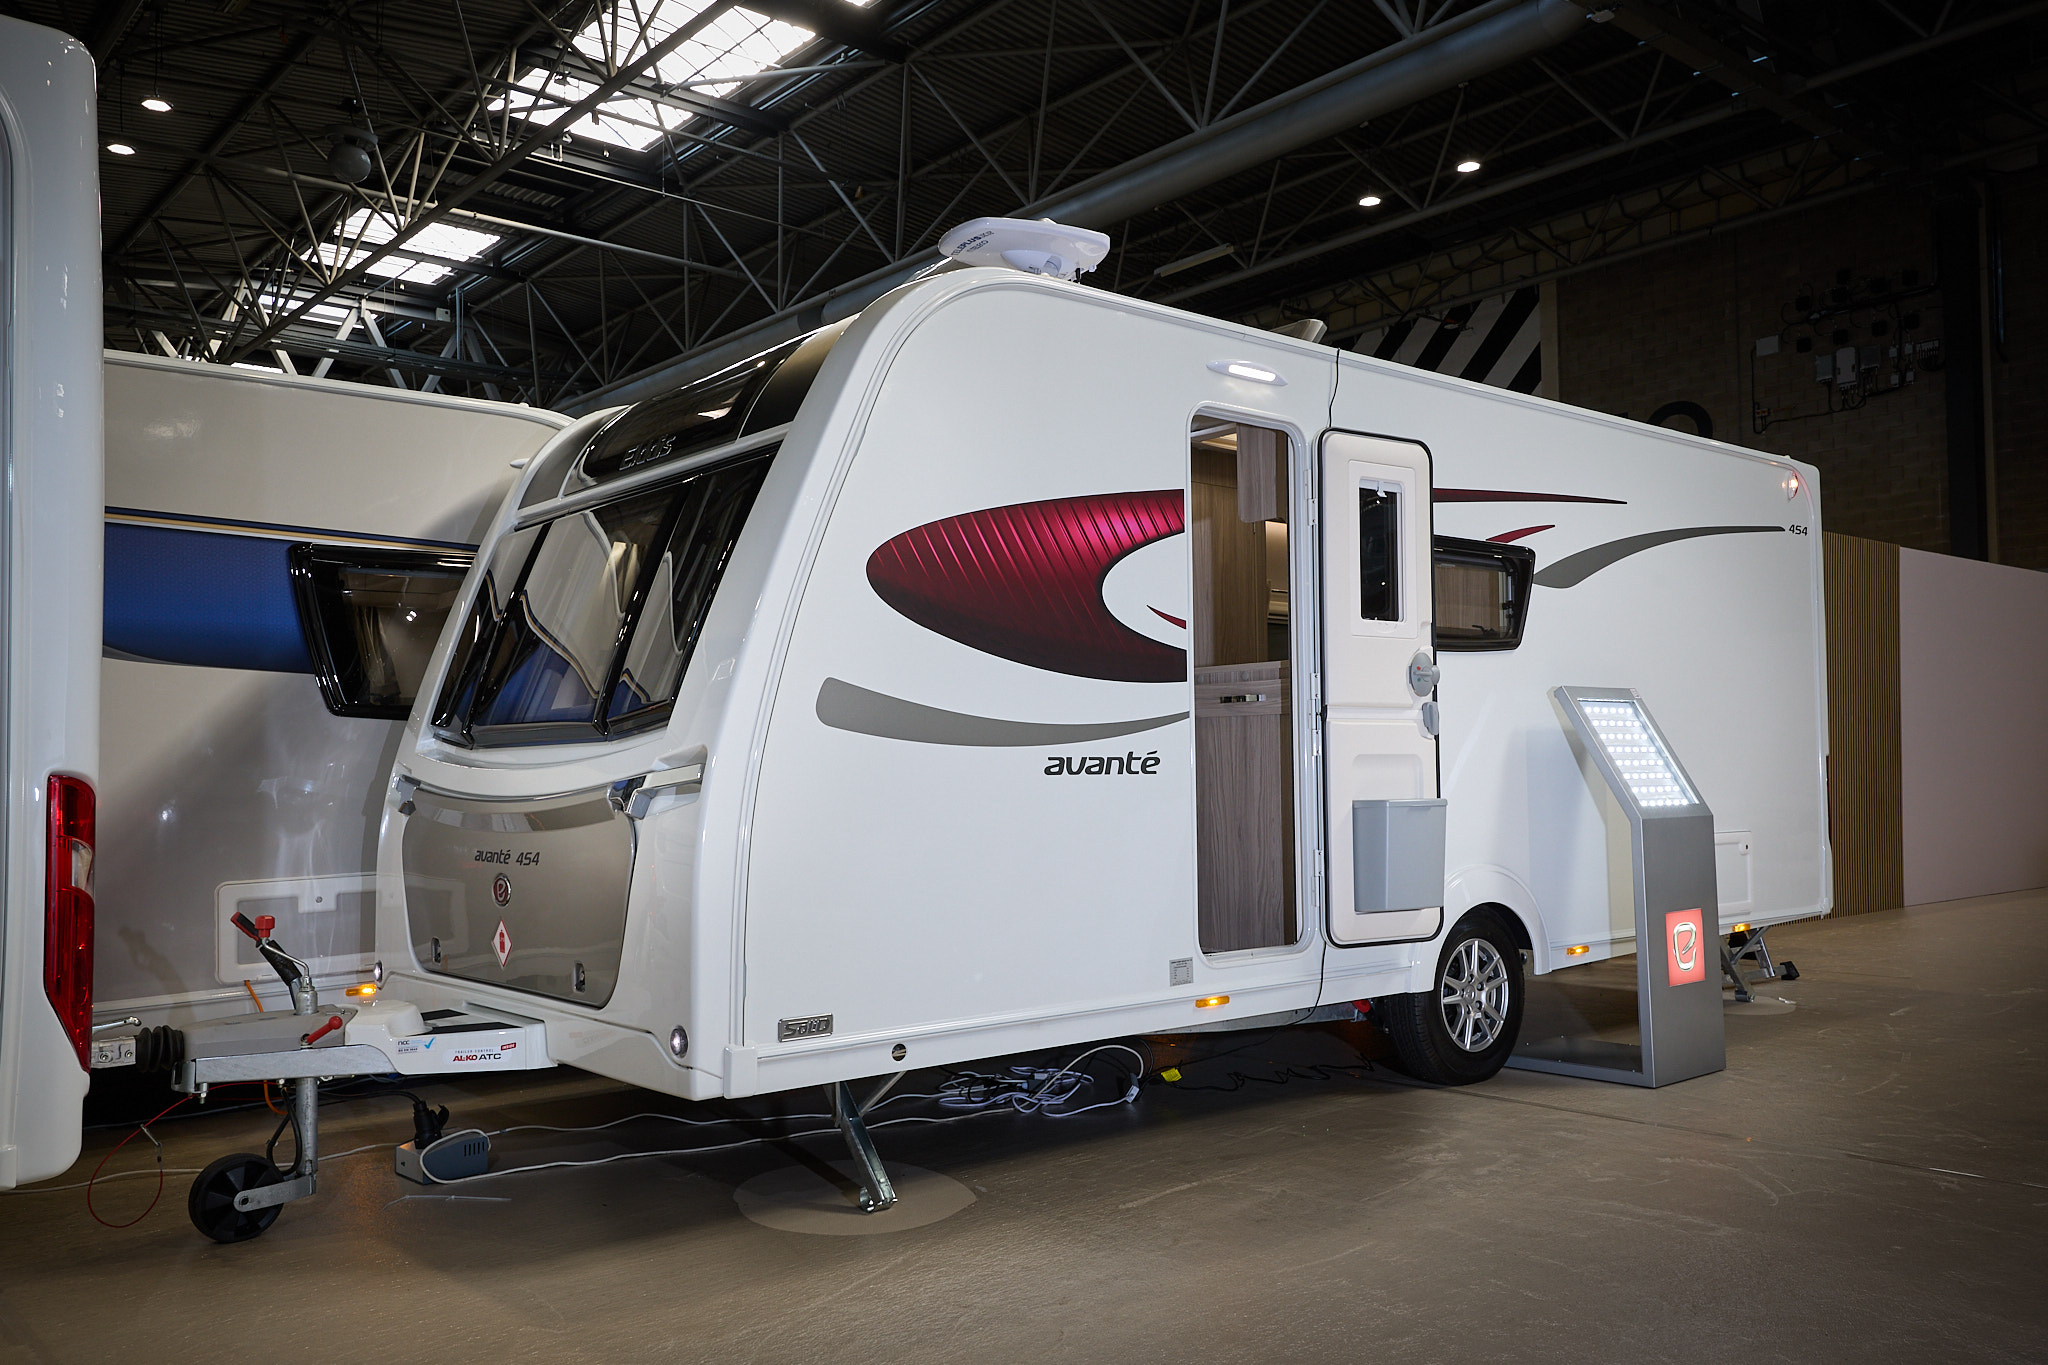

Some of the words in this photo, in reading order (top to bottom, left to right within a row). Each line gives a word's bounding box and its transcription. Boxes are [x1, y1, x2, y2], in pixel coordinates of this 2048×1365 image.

[1789, 524, 1808, 537] 454
[1044, 750, 1161, 776] avanté
[475, 849, 511, 865] avanté
[516, 852, 541, 866] 454
[478, 1053, 502, 1061] ATC
